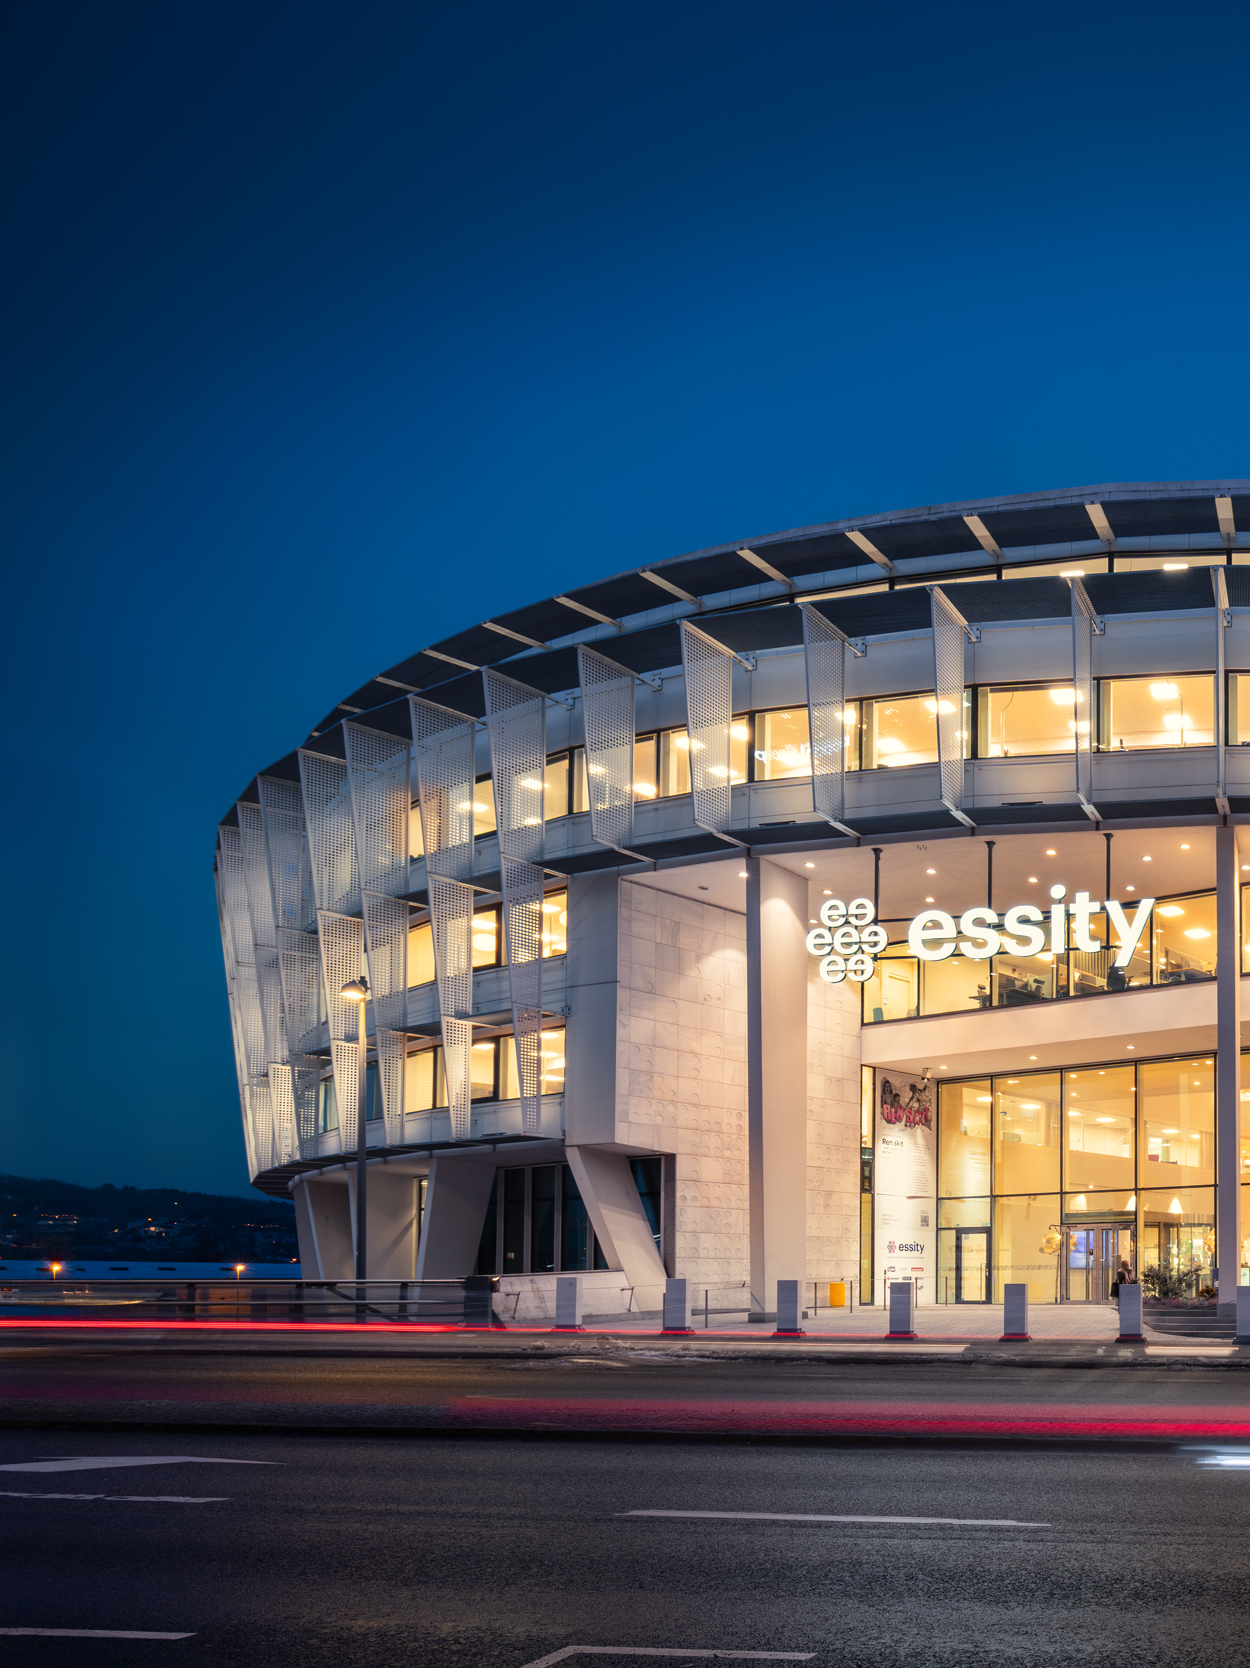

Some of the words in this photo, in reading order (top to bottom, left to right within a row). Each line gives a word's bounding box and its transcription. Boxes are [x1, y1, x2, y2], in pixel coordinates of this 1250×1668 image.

[908, 884, 1156, 967] essity
[883, 1104, 904, 1124] REN
[882, 1138, 893, 1146] Ren
[894, 1139, 904, 1148] skit
[898, 1241, 925, 1254] essity
